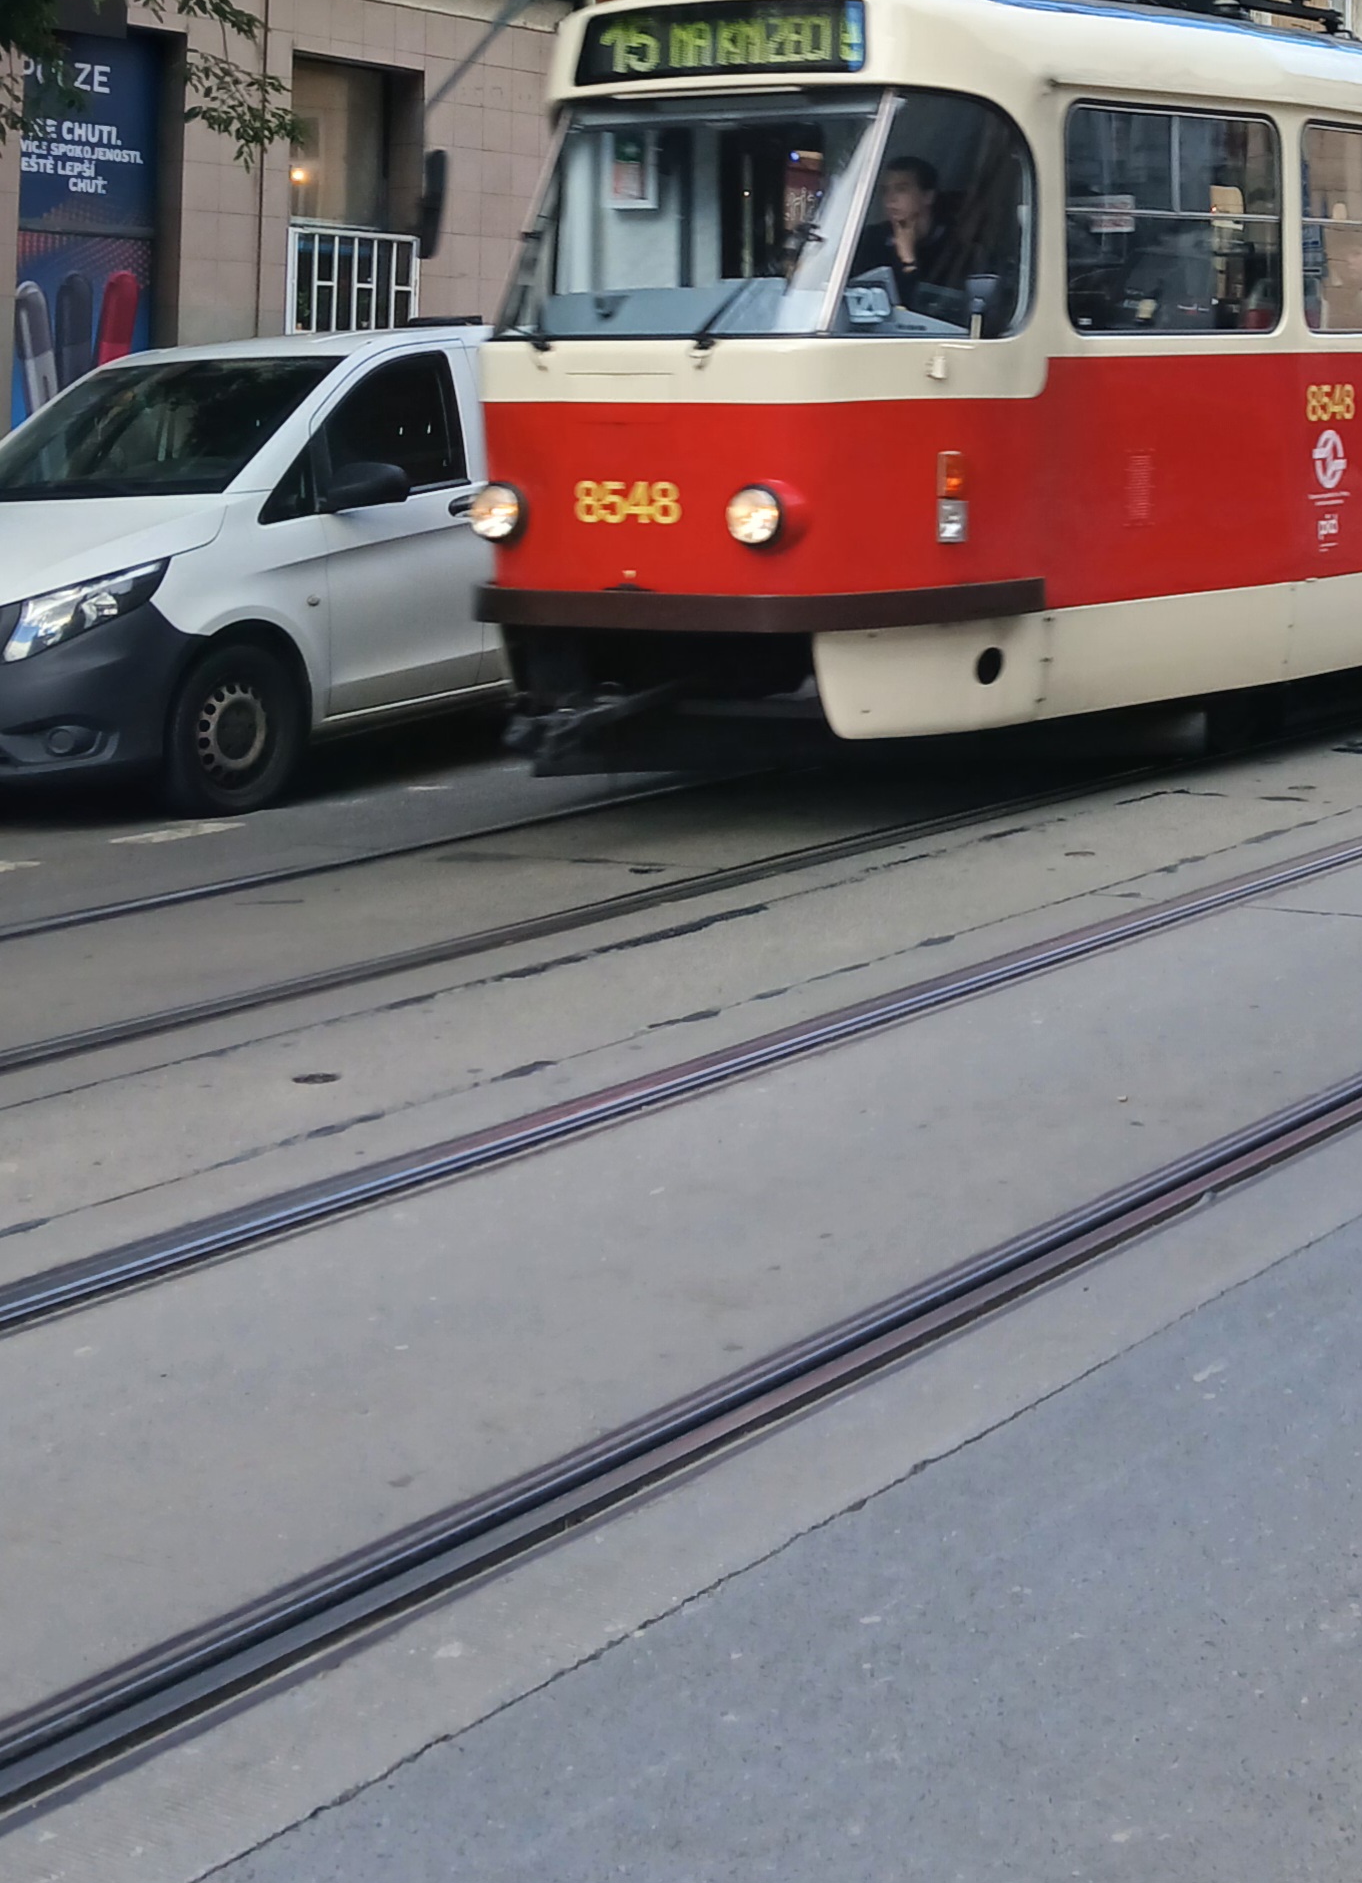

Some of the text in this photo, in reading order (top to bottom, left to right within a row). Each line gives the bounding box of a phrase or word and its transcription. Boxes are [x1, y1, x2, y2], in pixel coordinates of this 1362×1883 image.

[600, 20, 661, 73] 15
[62, 121, 122, 146] CHUTI.
[57, 160, 97, 178] LEPŠÍ
[1306, 384, 1355, 421] 8548
[574, 480, 682, 524] 8548
